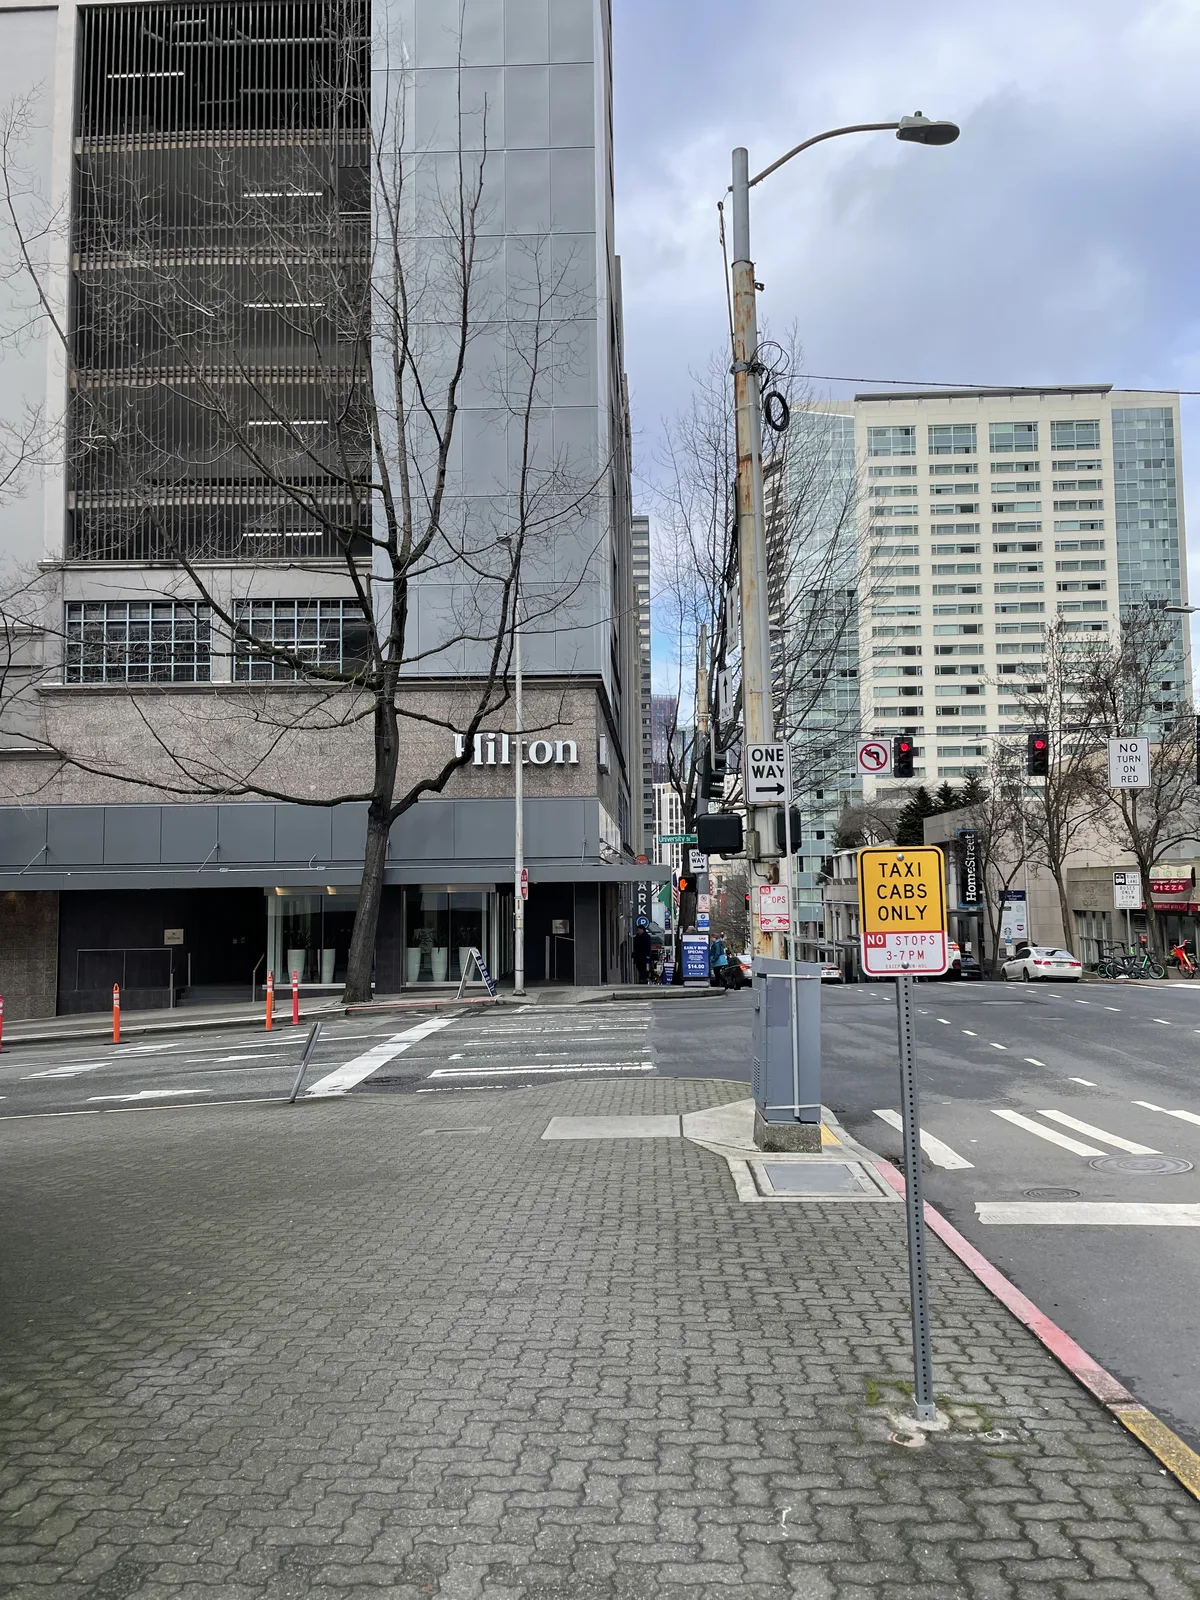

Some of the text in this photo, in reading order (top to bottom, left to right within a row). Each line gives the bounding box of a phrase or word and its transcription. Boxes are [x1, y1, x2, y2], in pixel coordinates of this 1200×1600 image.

[751, 748, 784, 762] ONE
[1119, 743, 1138, 753] NO
[1117, 755, 1141, 763] TURN
[751, 765, 785, 779] WAY
[1123, 765, 1136, 773] ON
[1121, 775, 1139, 783] RED
[878, 862, 922, 878] TAXI
[965, 834, 977, 902] HomeStreet
[638, 881, 647, 914] ARK
[877, 883, 928, 899] CABS
[764, 896, 786, 904] OPS
[877, 904, 928, 921] ONLY
[867, 934, 935, 946] NO STOPS
